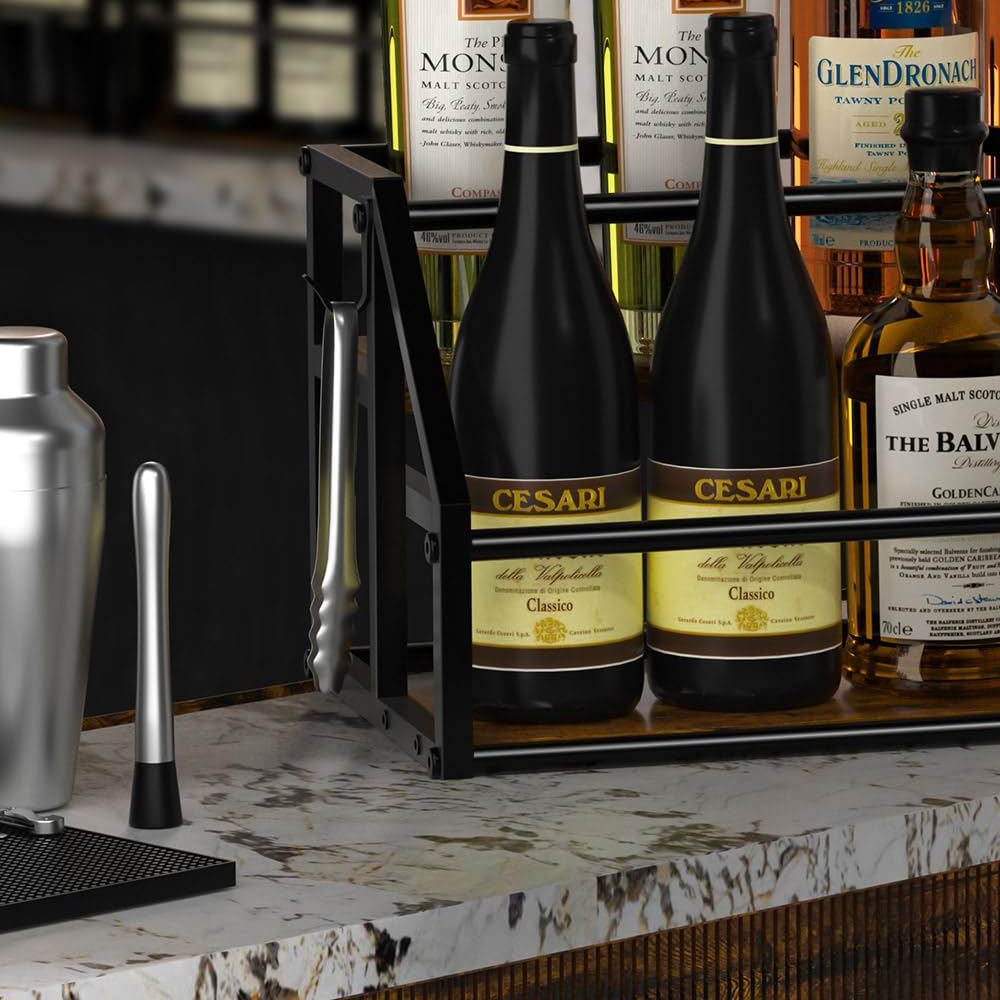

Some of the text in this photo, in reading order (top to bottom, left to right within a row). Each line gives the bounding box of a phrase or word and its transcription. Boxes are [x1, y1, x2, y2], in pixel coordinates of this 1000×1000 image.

[897, 1, 930, 14] 1826
[464, 37, 488, 48] The
[679, 30, 702, 41] The
[893, 44, 921, 58] The
[635, 73, 672, 82] MALT
[421, 81, 460, 89] MALT
[834, 95, 882, 105] TAWNY
[855, 120, 887, 128] AGED
[893, 396, 932, 416] SINGLE
[935, 391, 966, 404] MALT
[885, 435, 930, 452] THE
[695, 475, 807, 502] CESARI
[492, 486, 607, 512] CESARI
[697, 552, 805, 575] della Valpolicella
[495, 564, 604, 586] della Valpolicella
[728, 586, 775, 601] Classico
[526, 597, 573, 613] Classico
